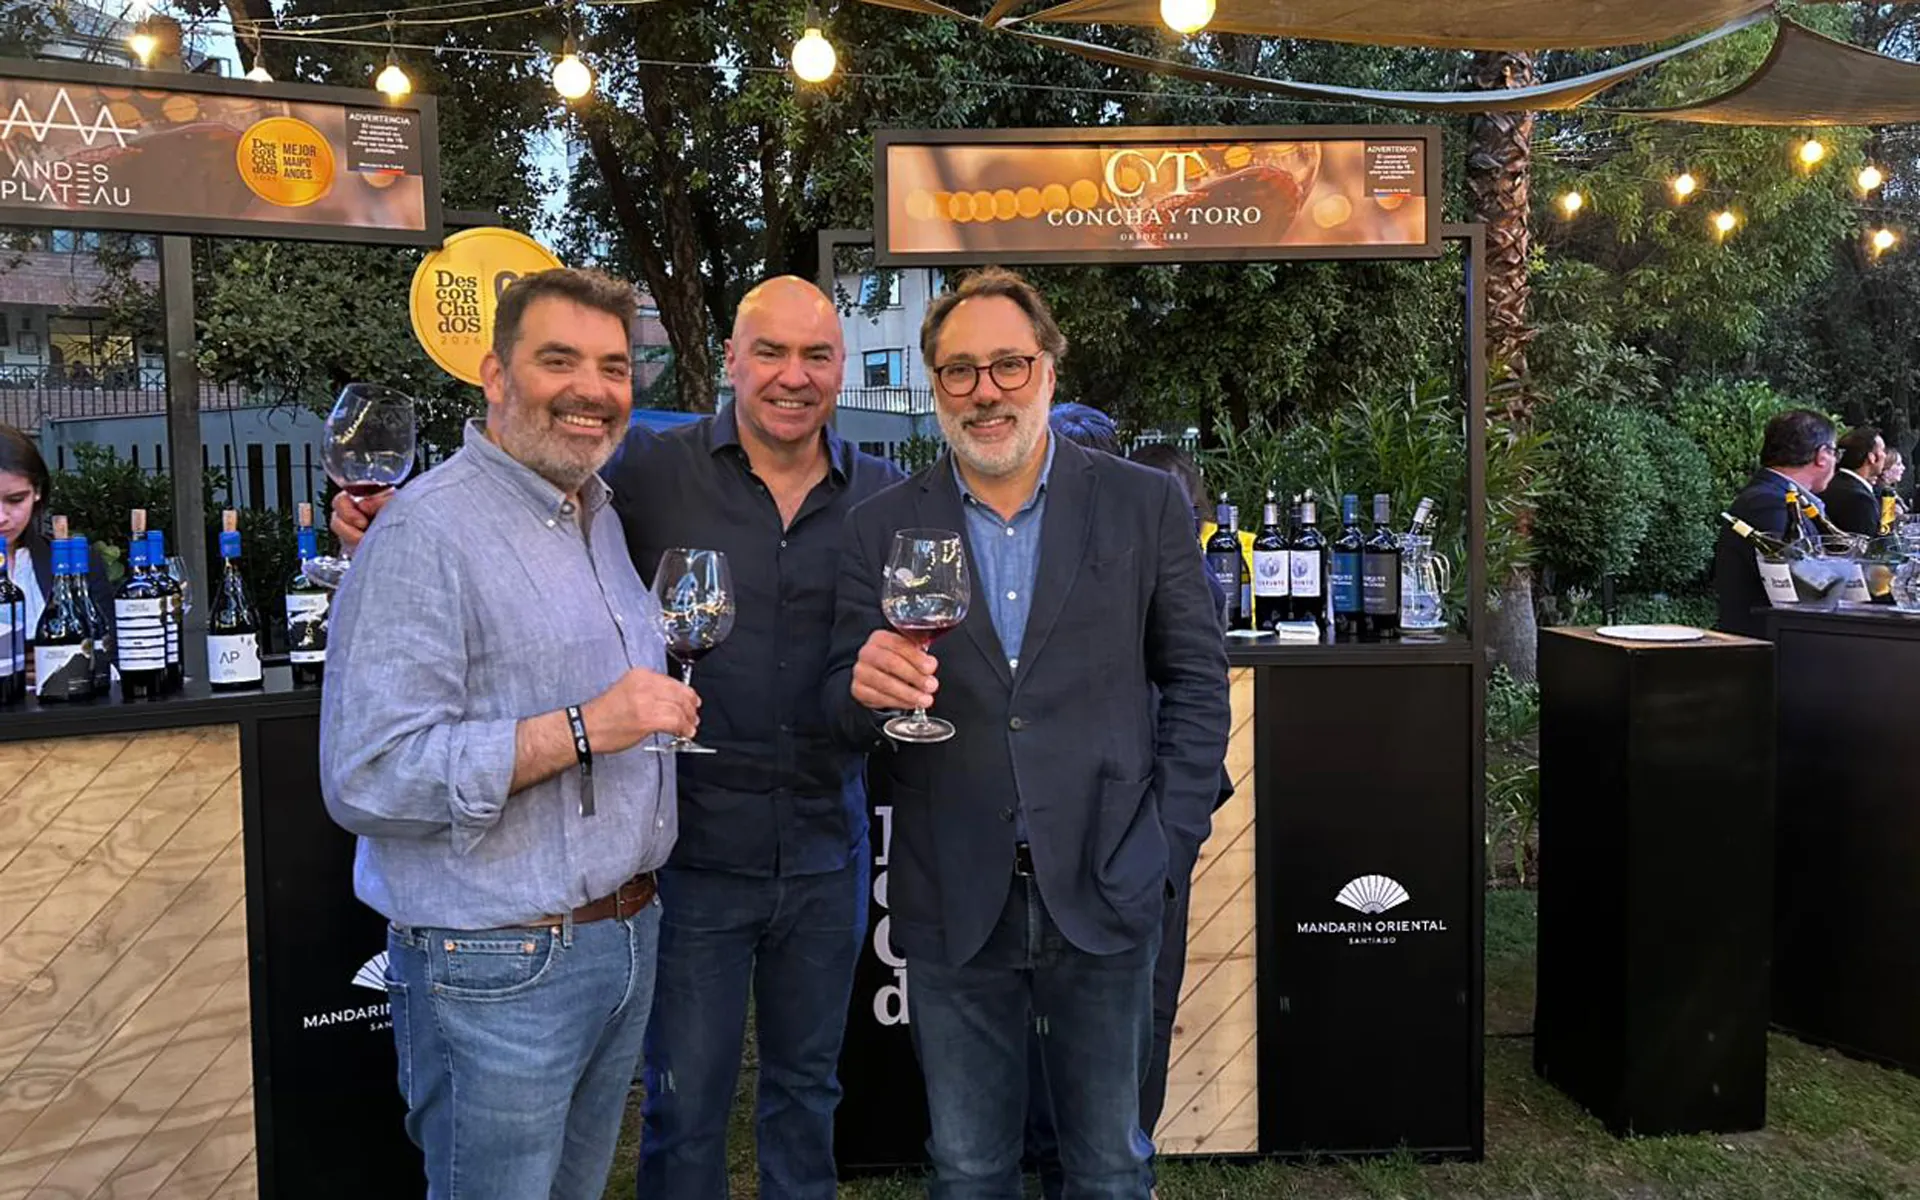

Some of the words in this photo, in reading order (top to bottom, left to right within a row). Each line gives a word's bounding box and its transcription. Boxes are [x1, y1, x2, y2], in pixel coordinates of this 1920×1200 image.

[349, 113, 411, 125] ADVERTENCIA
[283, 143, 316, 157] MEJOR
[1367, 145, 1418, 153] ADVERTENCIA
[12, 159, 109, 183] ANDES
[284, 168, 312, 180] ANDES
[1, 180, 131, 206] PLATEAU
[1047, 208, 1163, 226] CONCHA
[1168, 209, 1181, 224] Y
[1185, 207, 1262, 226] TORO
[435, 270, 477, 287] Des
[436, 301, 479, 317] Cha
[1297, 921, 1372, 933] MANDARIN
[1375, 919, 1447, 932] ORIENTAL
[1348, 936, 1397, 945] SANTIAGO
